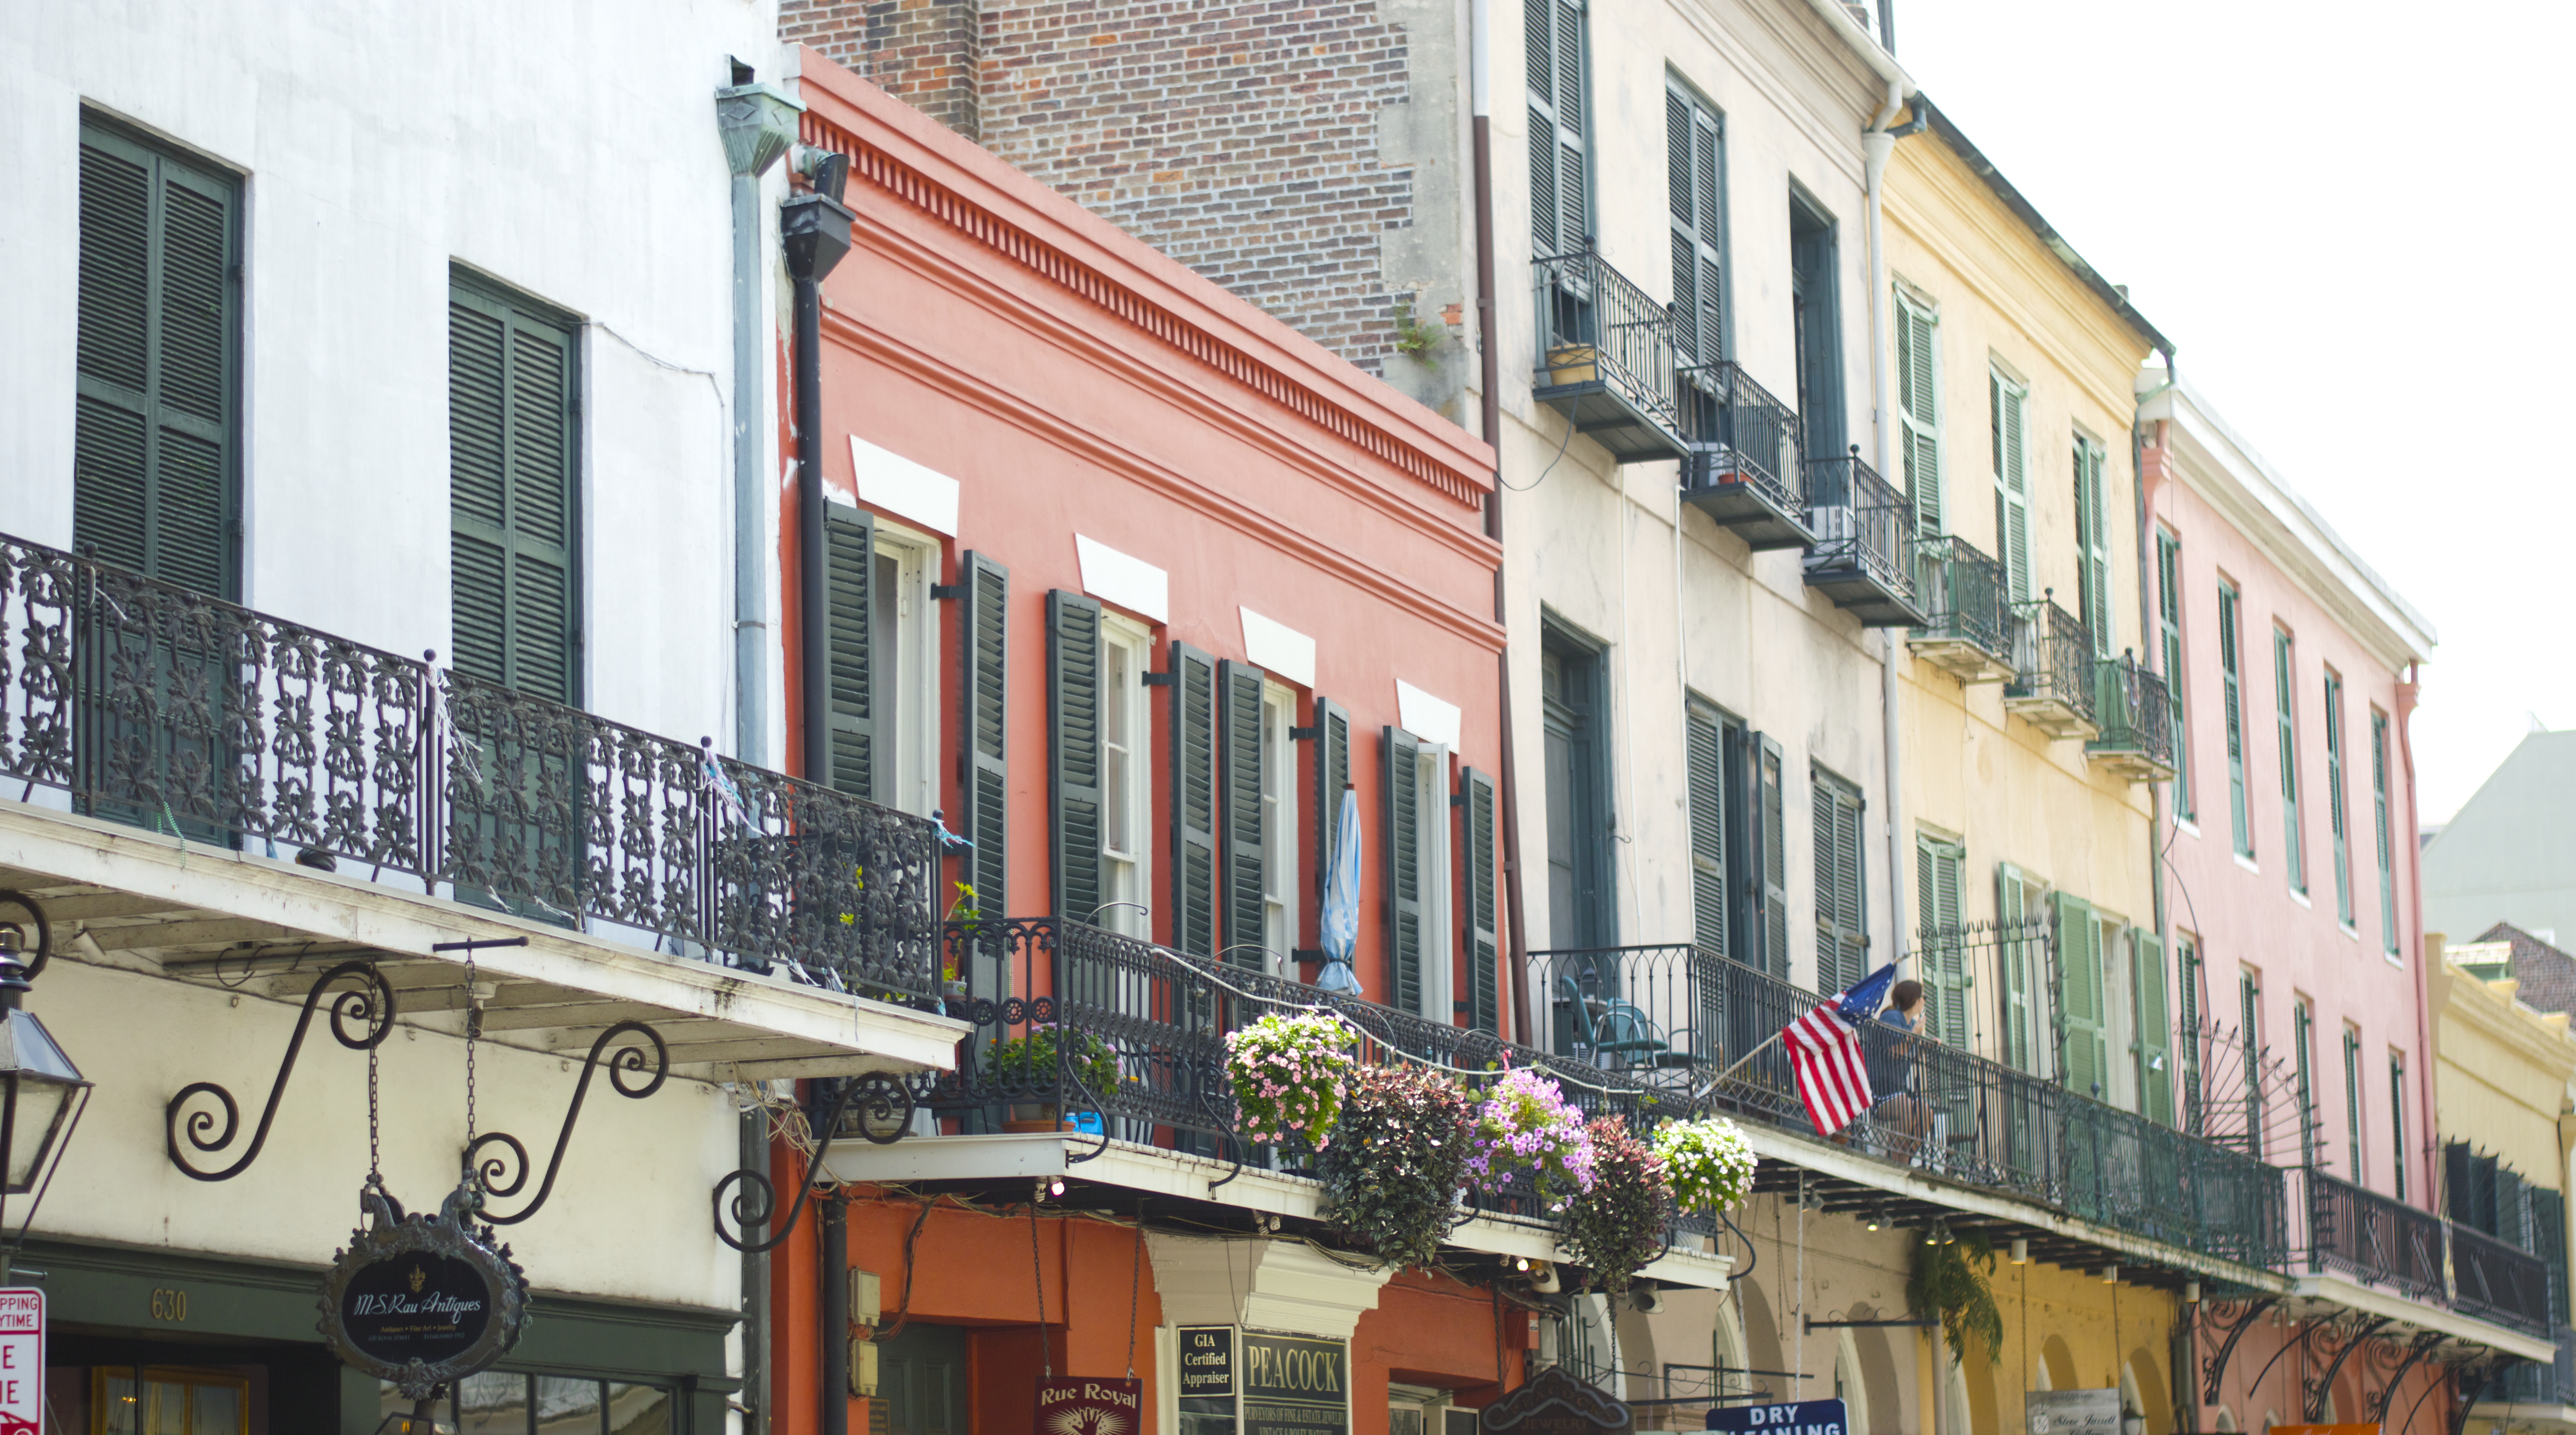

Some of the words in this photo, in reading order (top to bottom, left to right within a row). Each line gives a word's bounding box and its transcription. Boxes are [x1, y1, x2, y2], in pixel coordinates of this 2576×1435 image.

[152, 1288, 186, 1321] 630
[421, 1291, 481, 1324] Antiques
[1195, 1334, 1216, 1347] GIA
[1185, 1352, 1226, 1366] Certified
[1248, 1346, 1340, 1392] PEACOCK
[1183, 1371, 1230, 1387] Appraiser
[1041, 1388, 1078, 1406] Rue
[1085, 1383, 1136, 1409] Royal
[1509, 1385, 1600, 1416] PEACOCK
[1244, 1406, 1276, 1421] PURVEYORS
[1276, 1408, 1284, 1421] OF
[1285, 1408, 1297, 1422] FINE
[1298, 1409, 1302, 1423] &
[1302, 1409, 1321, 1423] ESTATE
[1322, 1411, 1345, 1425] JEWELRY
[1521, 1417, 1587, 1432] JEWELRY
[1750, 1405, 1798, 1425] DRY
